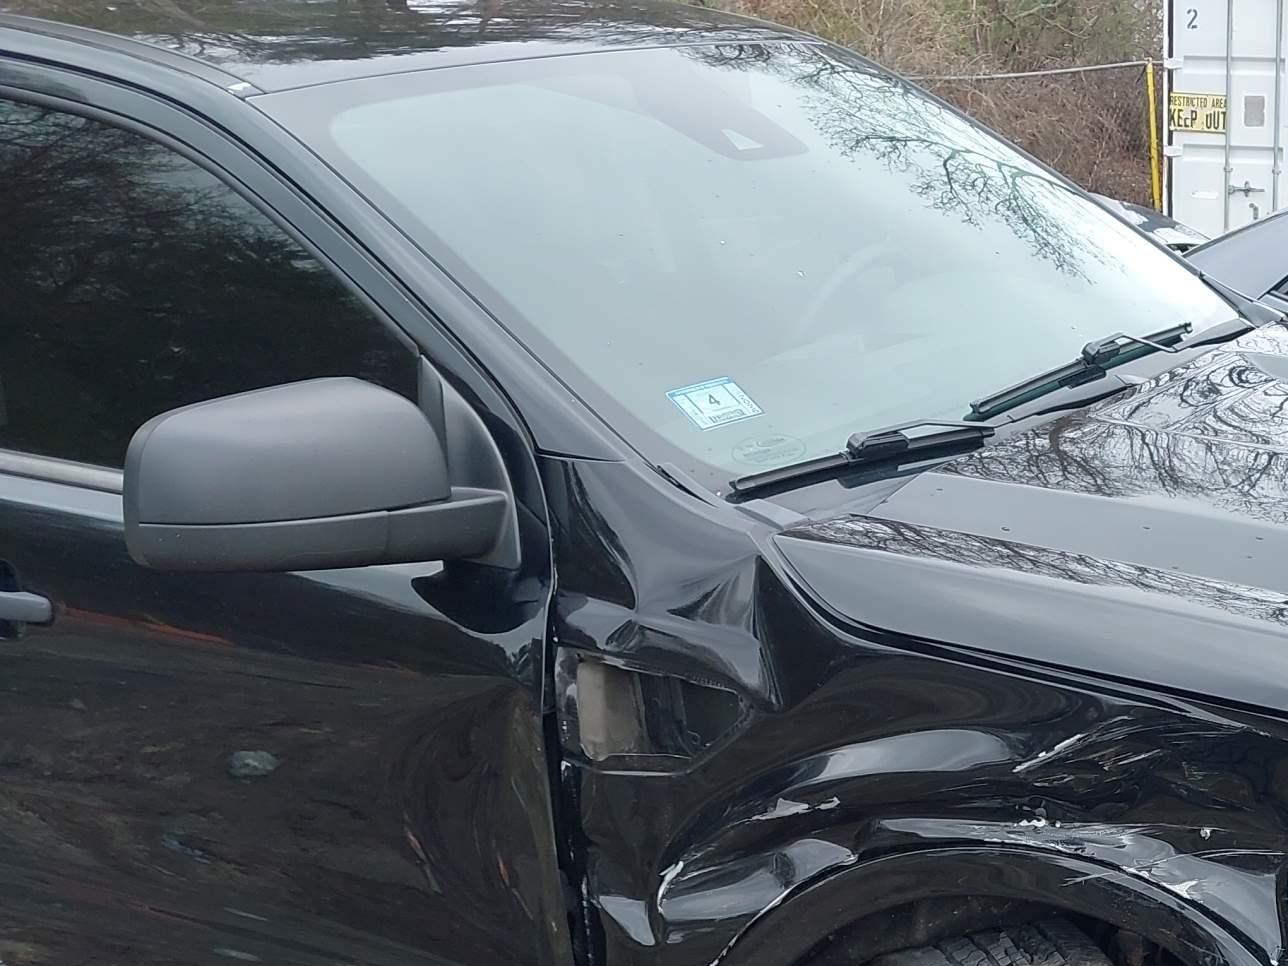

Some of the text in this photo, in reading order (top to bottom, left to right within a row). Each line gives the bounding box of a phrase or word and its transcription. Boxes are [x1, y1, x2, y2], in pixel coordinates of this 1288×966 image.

[1187, 8, 1198, 29] 2
[1170, 96, 1208, 108] RESTRICTED
[1206, 111, 1227, 130] OUT
[708, 394, 720, 405] 4
